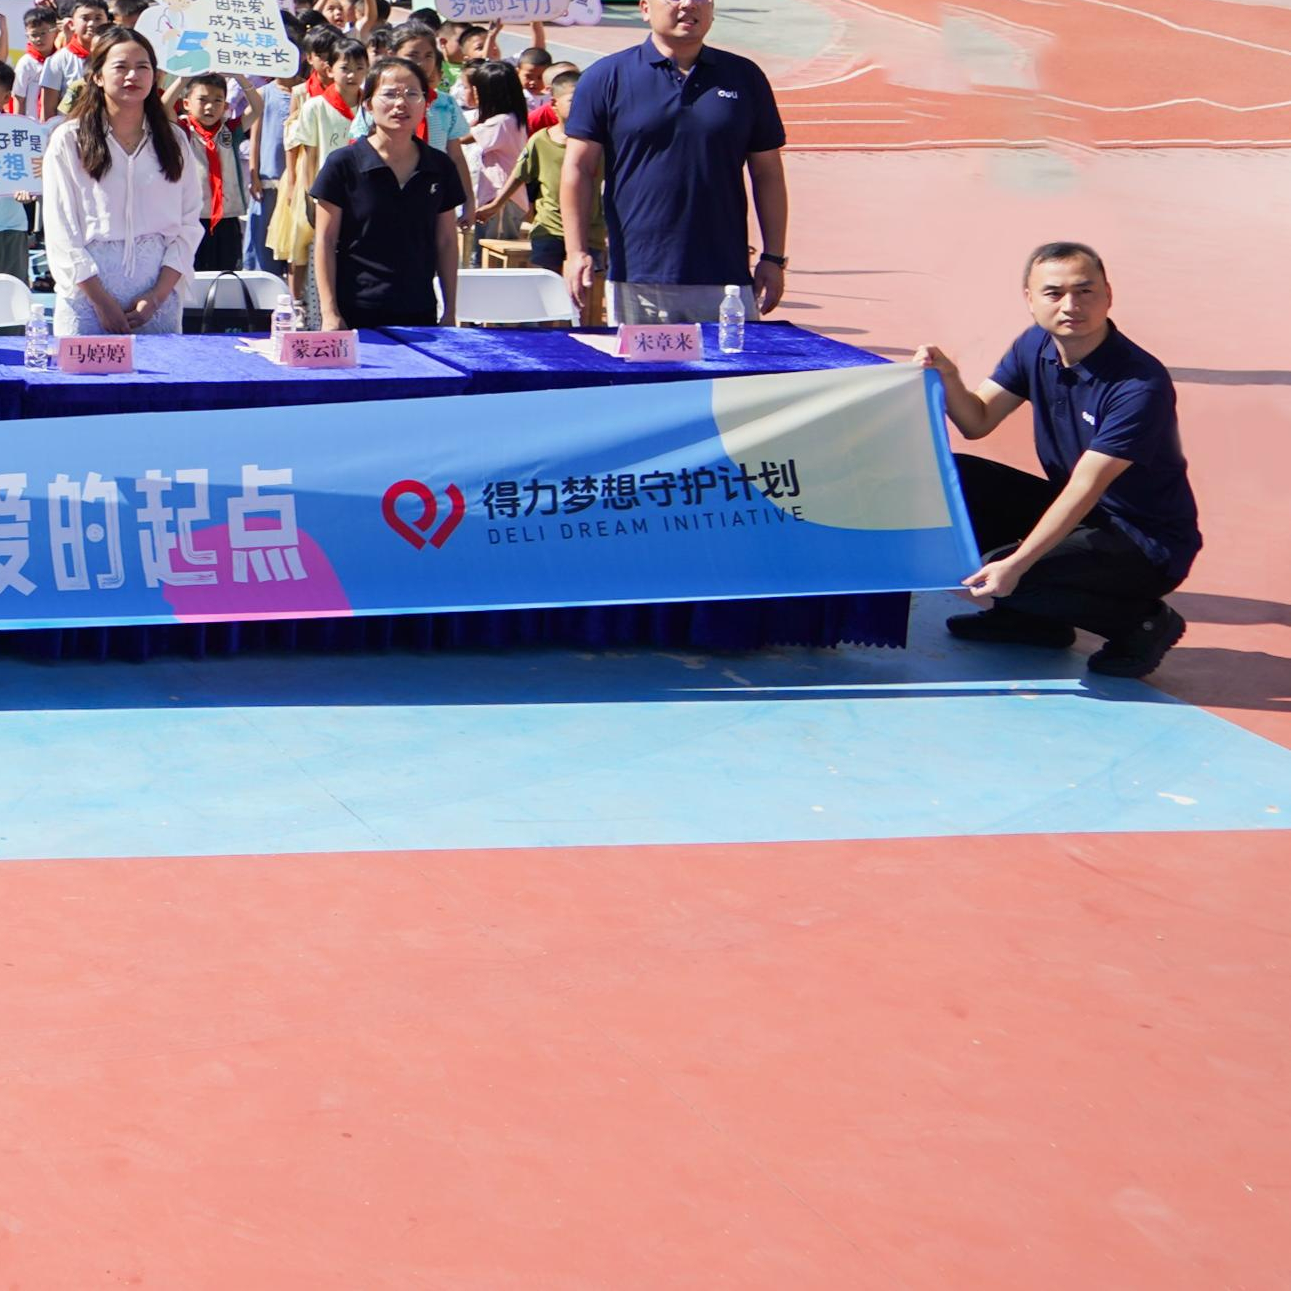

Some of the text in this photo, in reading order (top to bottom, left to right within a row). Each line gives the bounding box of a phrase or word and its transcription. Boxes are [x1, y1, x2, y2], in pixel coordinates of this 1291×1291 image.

[209, 15, 275, 31] 成为专业
[214, 31, 278, 48] 让兴趣
[217, 49, 290, 67] 自然生长
[718, 89, 738, 99] deli
[291, 338, 348, 359] 蒙云清
[634, 333, 693, 354] 宋章来
[68, 343, 127, 366] 马婷婷
[482, 459, 801, 520] 得力梦想守护计划
[487, 506, 805, 545] DELI DREAM INITIATIVE
